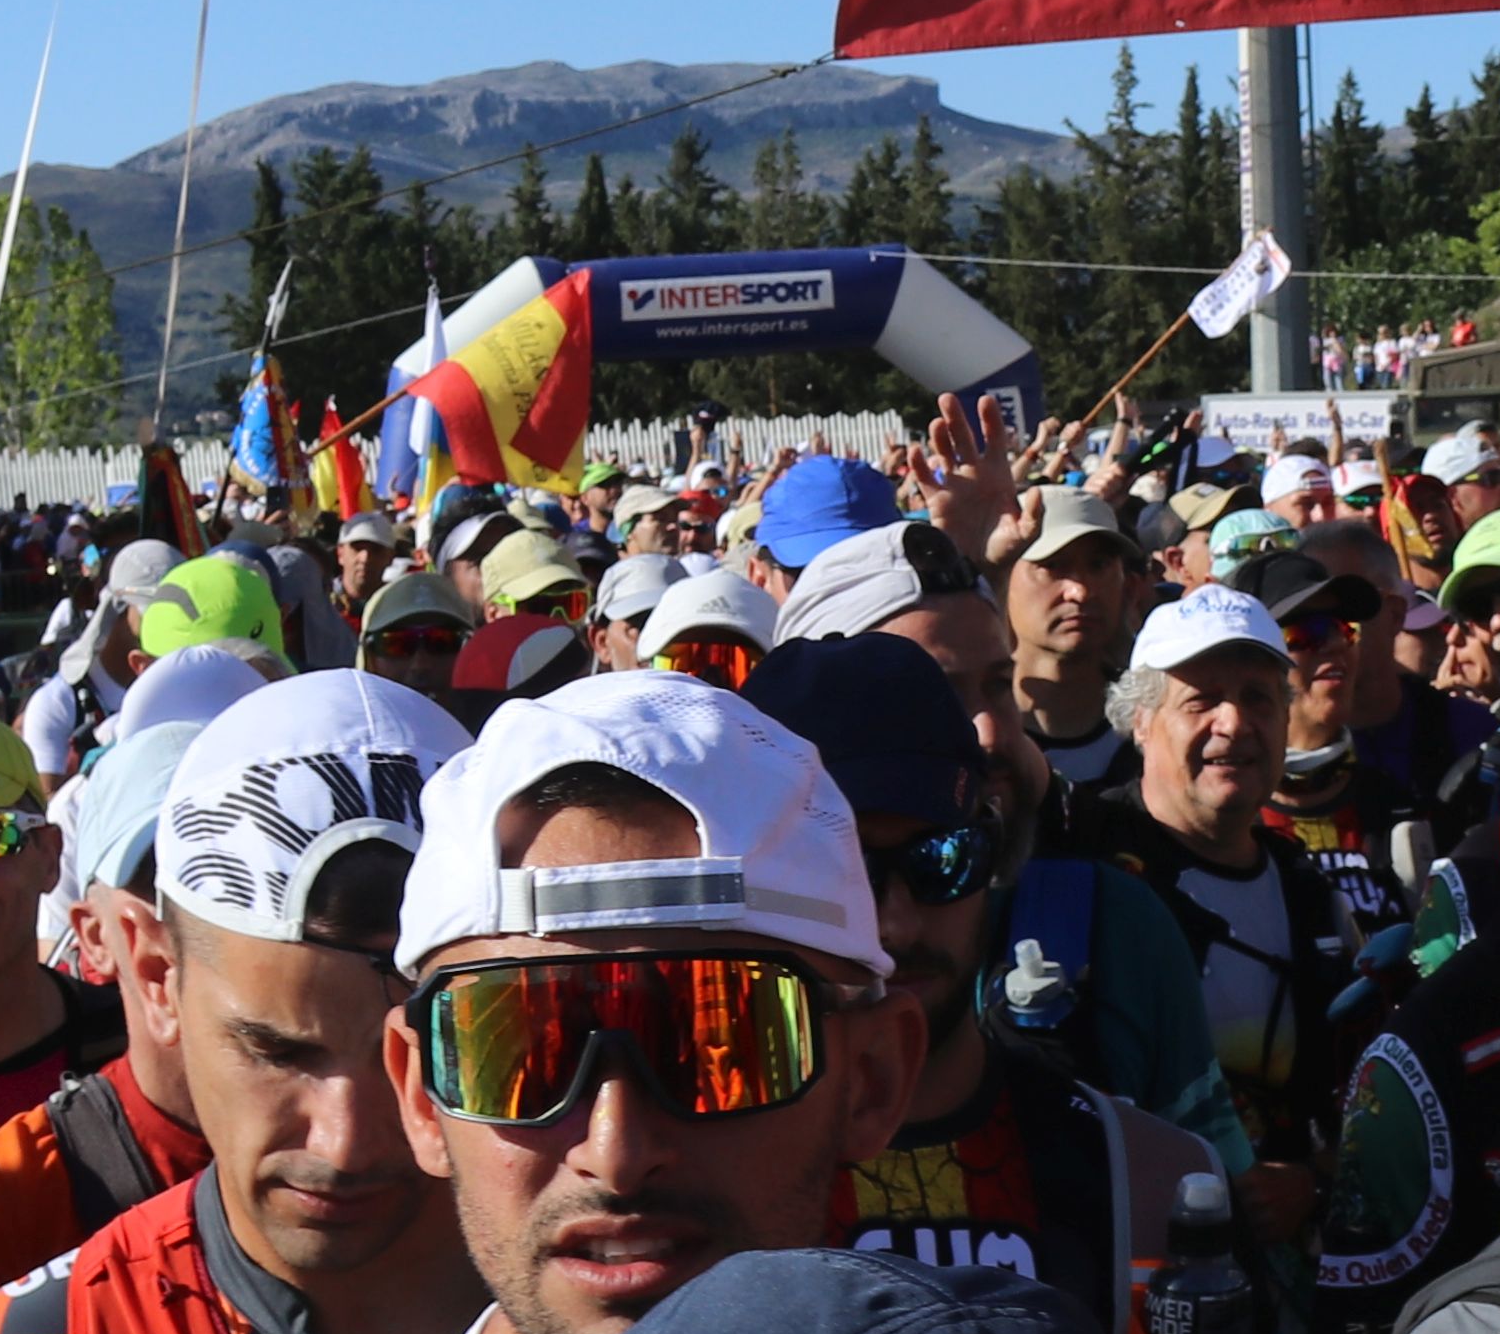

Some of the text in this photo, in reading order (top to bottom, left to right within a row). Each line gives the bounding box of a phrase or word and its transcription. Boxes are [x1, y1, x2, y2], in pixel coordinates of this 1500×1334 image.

[660, 280, 823, 310] INTERSPORT
[655, 318, 809, 339] www.intersport.es
[1384, 1035, 1450, 1171] Quien Quiera
[1345, 1254, 1411, 1285] Quien
